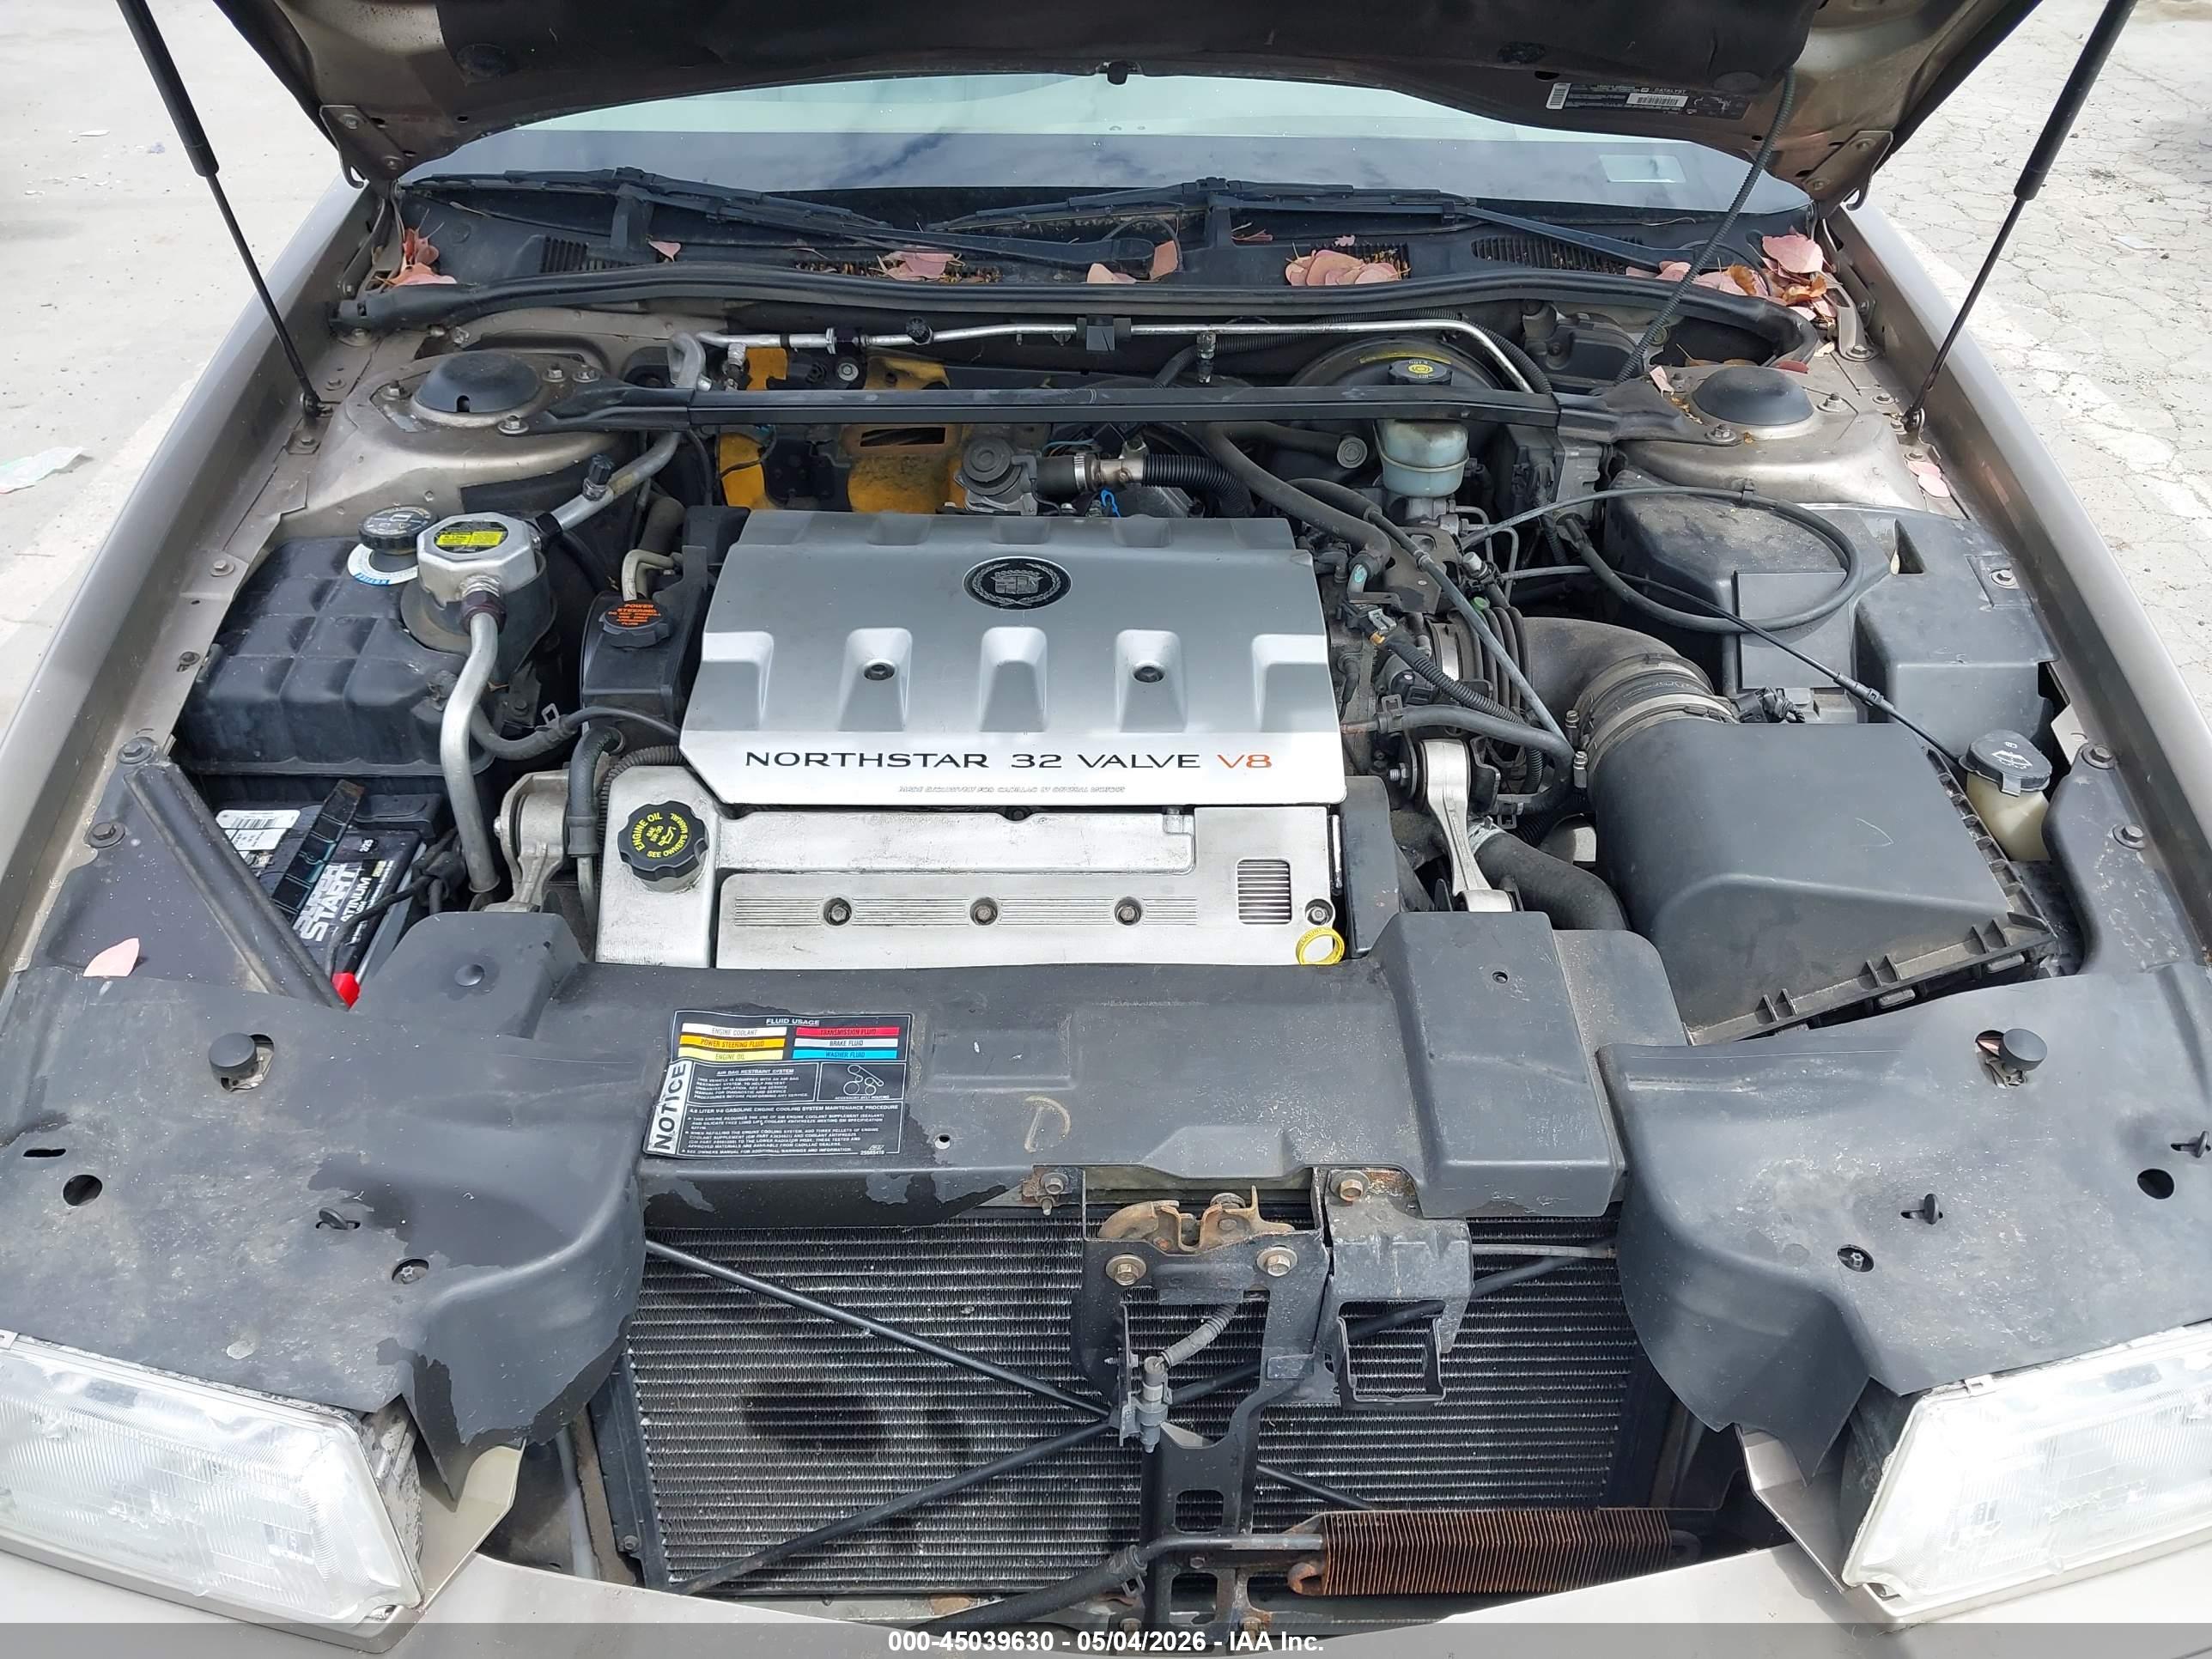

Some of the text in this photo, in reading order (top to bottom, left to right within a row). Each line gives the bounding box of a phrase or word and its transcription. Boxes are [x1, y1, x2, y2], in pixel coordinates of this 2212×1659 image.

[746, 752, 1273, 769] NORTHSTAR 32 VALVE V8
[632, 812, 662, 852] ENGINE OIL
[670, 812, 688, 834] MANUAL
[301, 862, 356, 941] START
[653, 1064, 687, 1150] NOTICE
